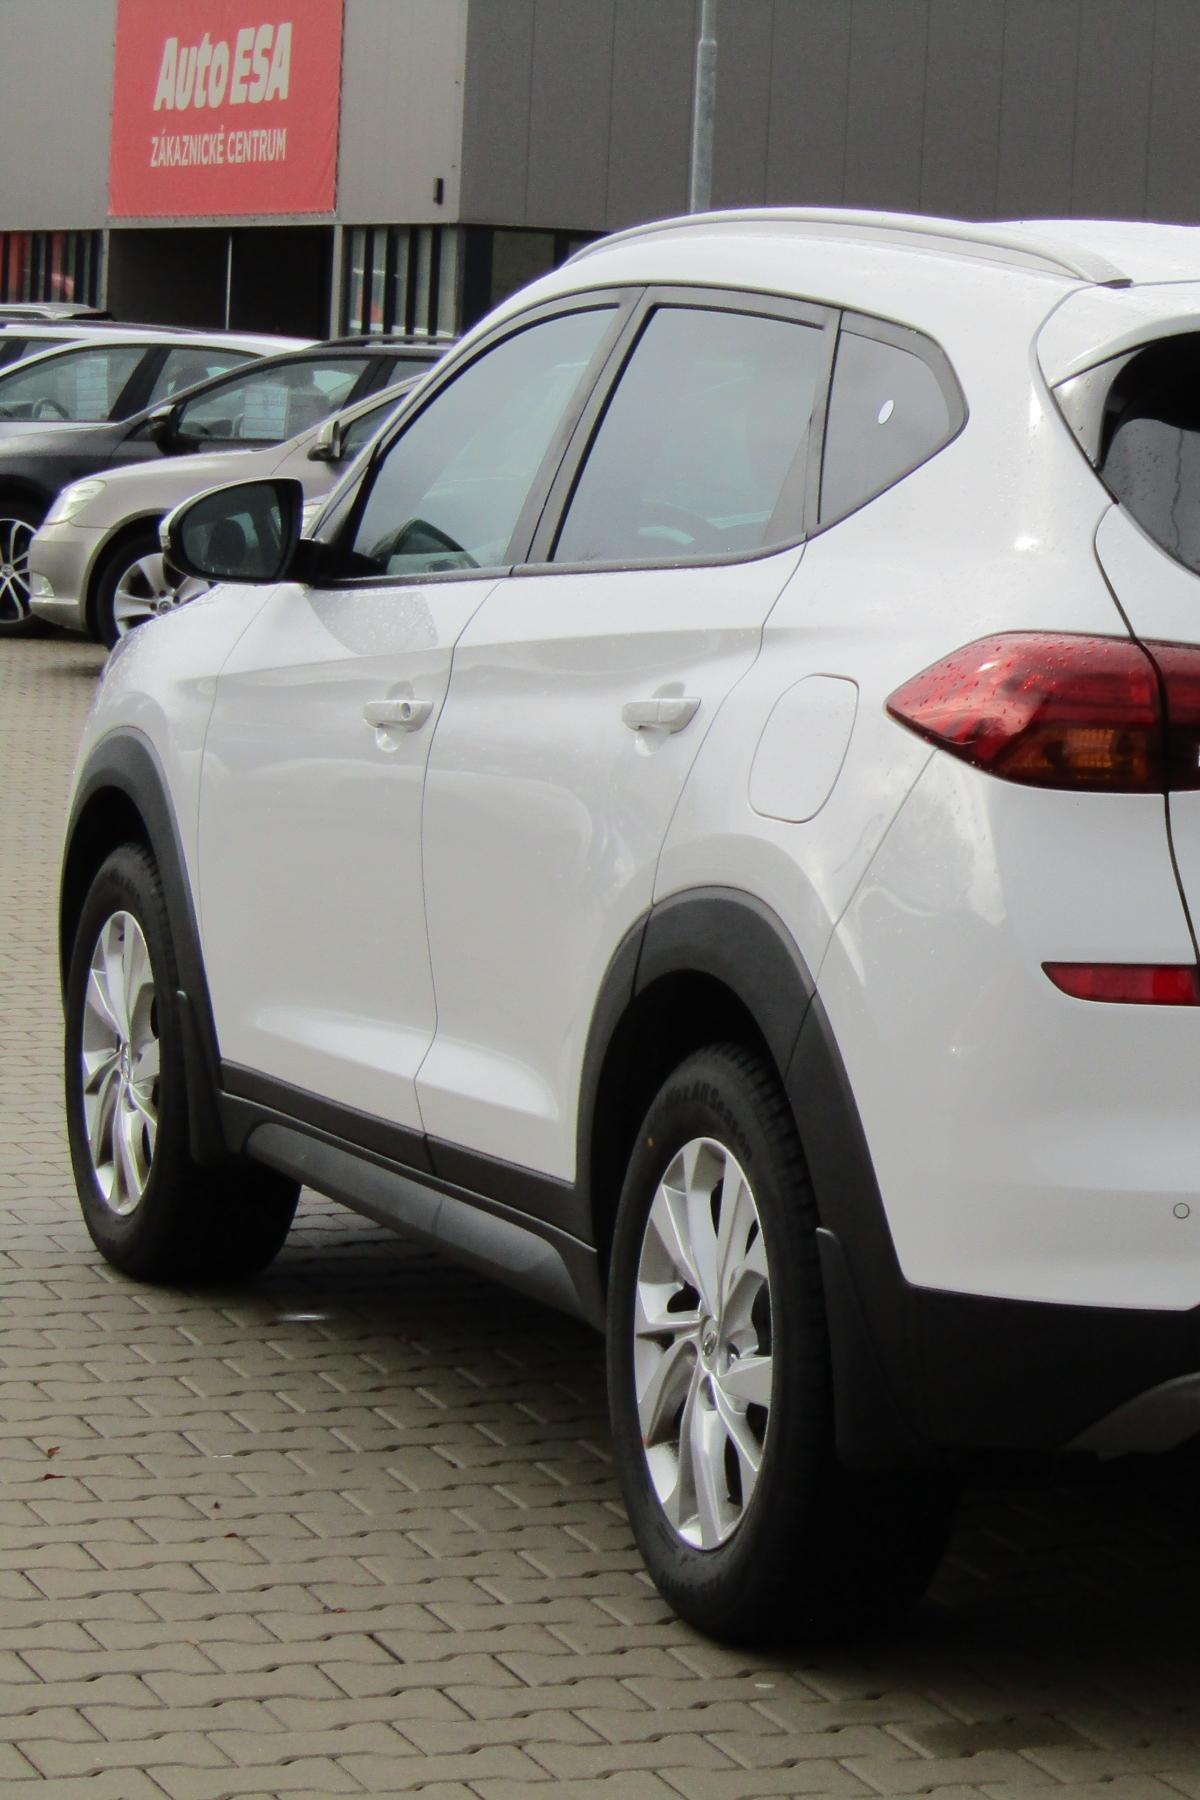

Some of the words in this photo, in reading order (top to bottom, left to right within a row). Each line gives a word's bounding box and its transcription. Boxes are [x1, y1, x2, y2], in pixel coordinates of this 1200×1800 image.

[153, 32, 230, 111] Auto
[229, 22, 292, 104] ESA
[150, 124, 225, 167] ZÁKAZNICKÉ
[227, 127, 287, 163] CENTRUM
